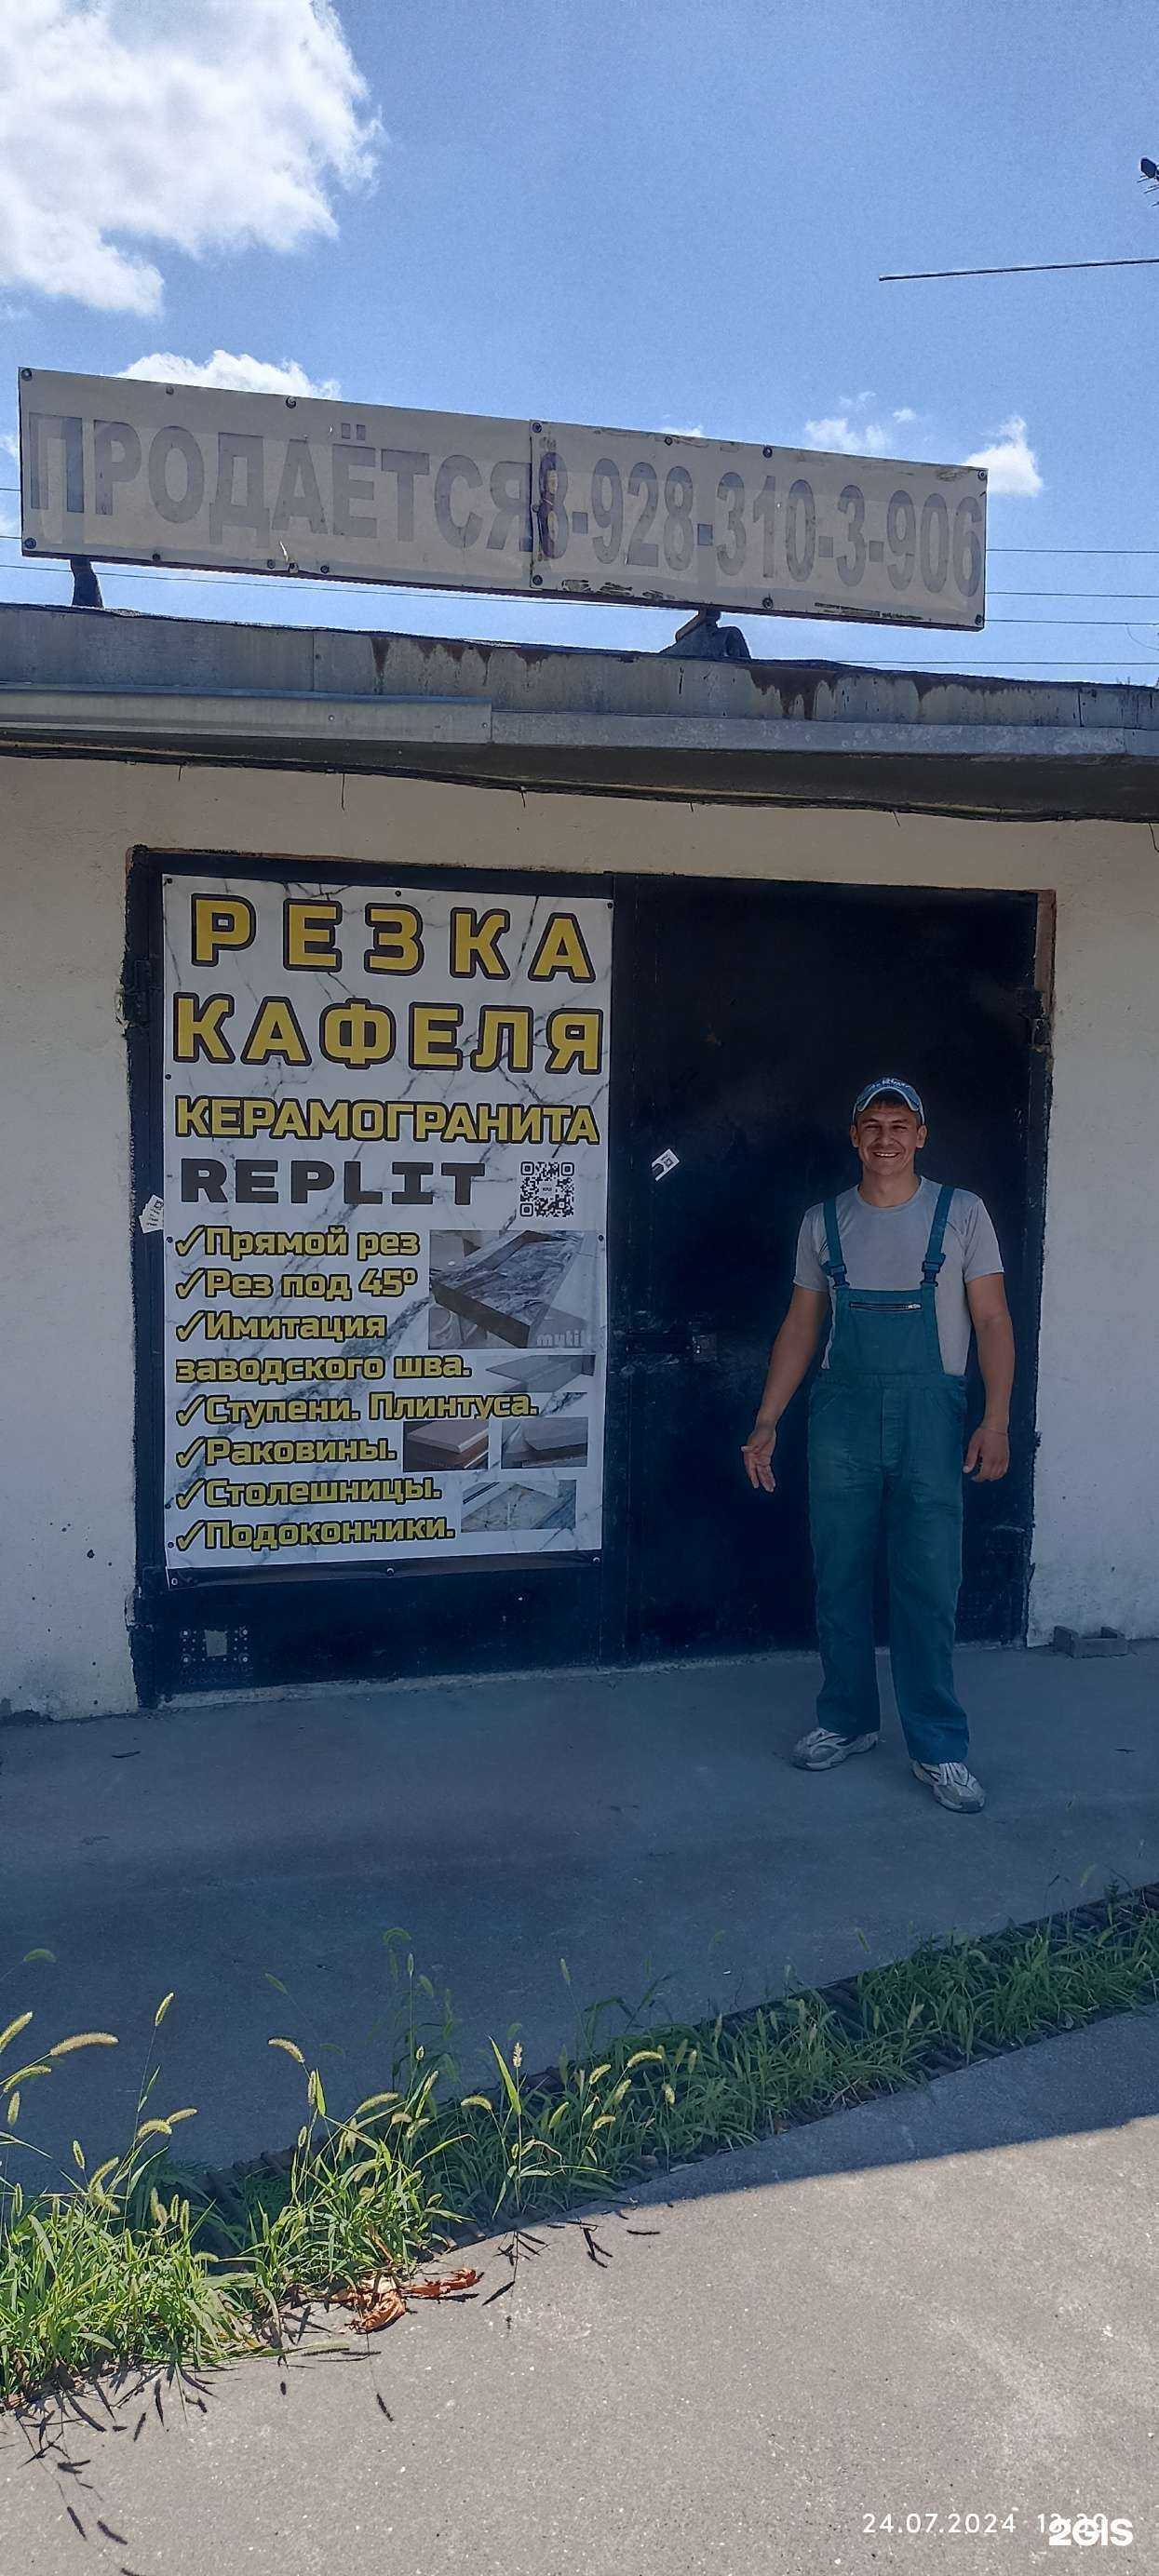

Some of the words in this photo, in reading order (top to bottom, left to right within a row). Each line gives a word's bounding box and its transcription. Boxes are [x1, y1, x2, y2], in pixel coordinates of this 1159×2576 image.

[28, 412, 532, 553] ПРОДАЁТСЯ
[536, 450, 984, 597] 8-928-310-3-906
[191, 892, 597, 984] РЕЗКА
[172, 992, 604, 1074] КАФЕЛЯ
[175, 1095, 601, 1145] КЕРАМОГРАНИТА
[181, 1158, 486, 1206] REPLIT
[203, 1226, 350, 1261] Прямой
[357, 1237, 421, 1260] рез
[205, 1268, 274, 1298] Рез
[281, 1276, 352, 1300] под
[205, 1311, 388, 1341] Имитация
[175, 1355, 385, 1384] заводского
[393, 1354, 472, 1378] шва.
[205, 1395, 361, 1427] Ступени.
[369, 1392, 540, 1421] Плинтуса.
[205, 1436, 398, 1467] Раковины.
[205, 1477, 443, 1509] Столешницы.
[205, 1517, 456, 1550] Подоконники.
